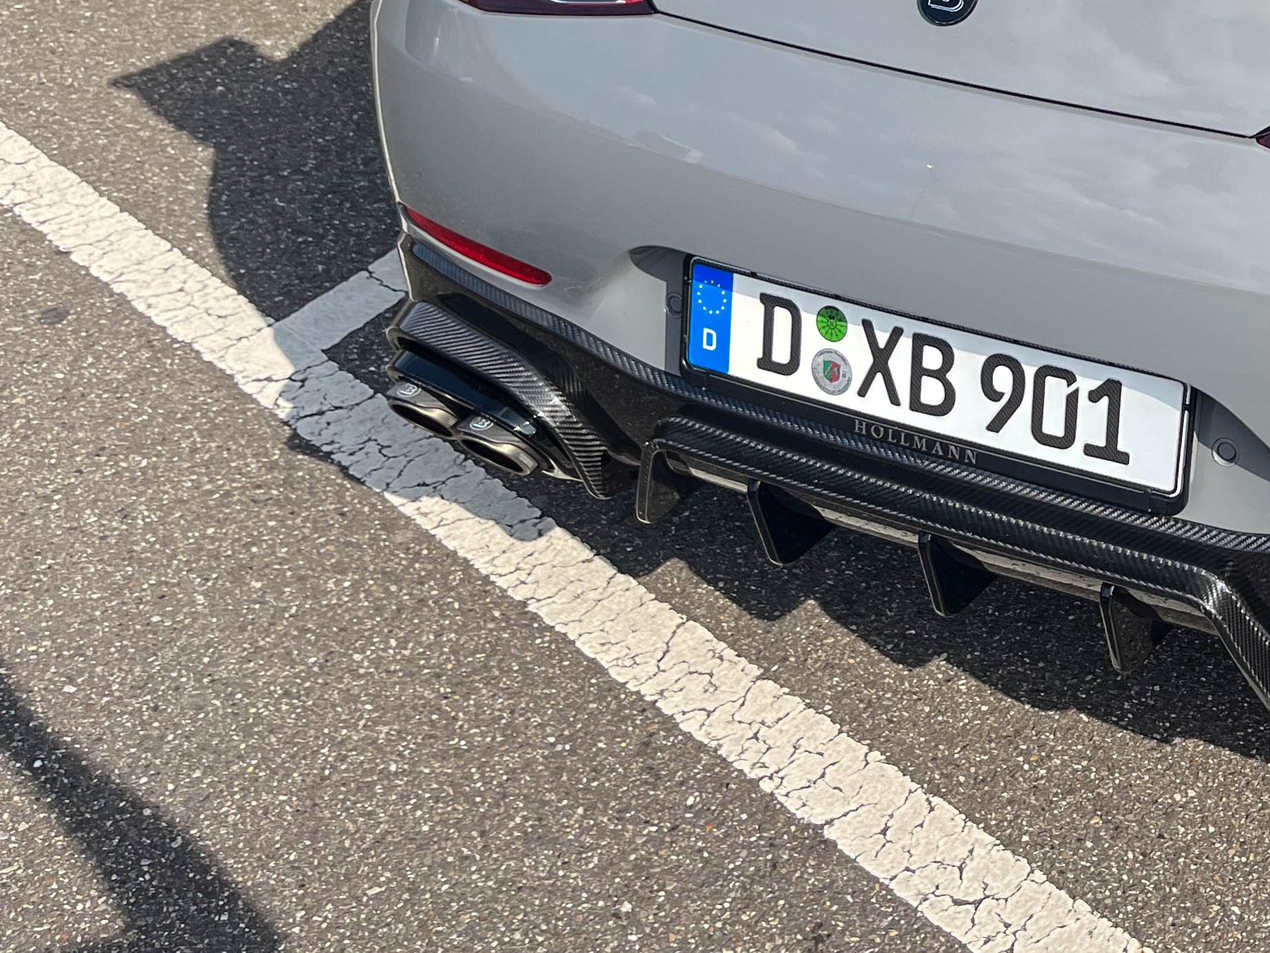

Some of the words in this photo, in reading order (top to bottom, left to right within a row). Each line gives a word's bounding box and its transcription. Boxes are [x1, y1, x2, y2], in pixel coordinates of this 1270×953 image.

[702, 327, 717, 351] D
[756, 292, 802, 377] D
[856, 318, 957, 417] XB
[980, 352, 1130, 466] 901
[853, 419, 979, 465] HOLLMANN
